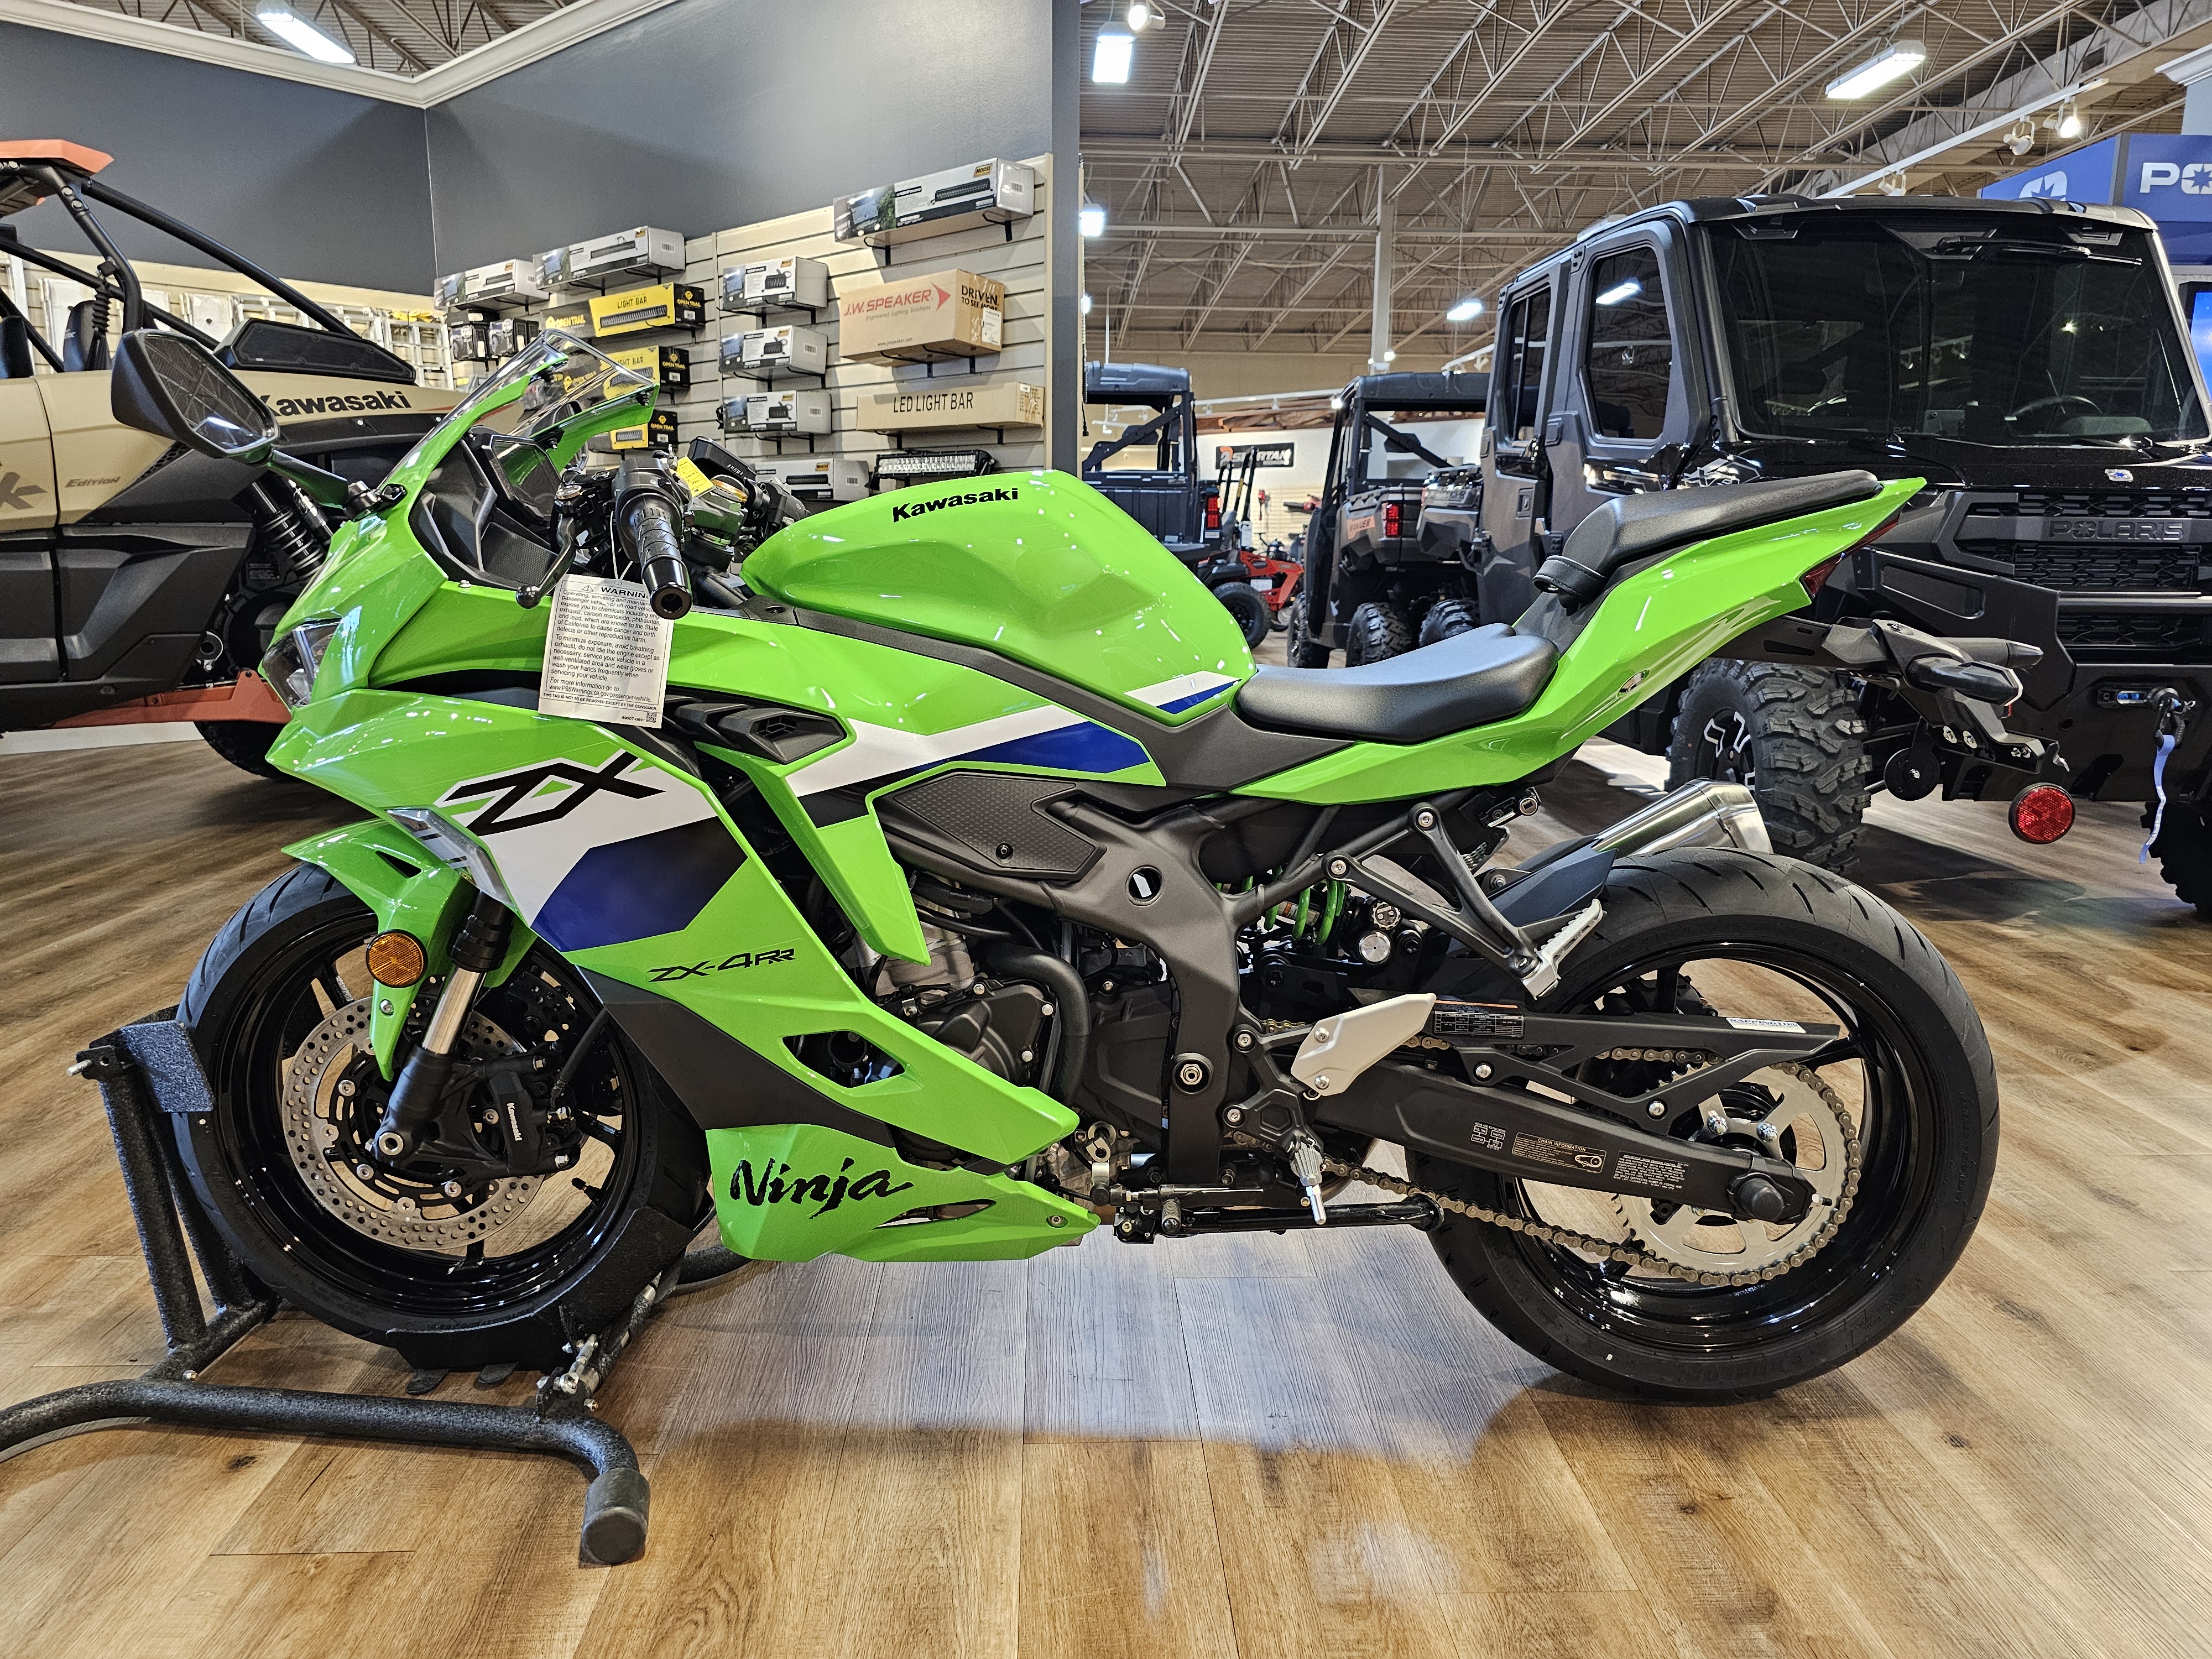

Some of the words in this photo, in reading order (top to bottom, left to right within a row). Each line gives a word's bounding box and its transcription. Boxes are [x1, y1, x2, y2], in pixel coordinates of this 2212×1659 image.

[976, 165, 991, 174] MOOSE
[2140, 162, 2212, 194] PO
[618, 299, 633, 309] LIGHT
[636, 296, 647, 305] BAR
[844, 302, 864, 317] J.W.
[867, 289, 932, 312] SPEAKER
[971, 300, 979, 308] SEE
[866, 312, 890, 321] Engineered
[891, 309, 909, 318] Lighting
[894, 396, 912, 413] LED
[916, 394, 948, 412] LIGHT
[951, 392, 973, 410] BAR
[1233, 450, 1291, 462] SPRTAN
[893, 488, 1018, 523] Kawasaki
[2049, 520, 2184, 540] POLARIS
[601, 587, 649, 598] WARNIN
[625, 609, 648, 618] including
[629, 644, 654, 654] breathing
[553, 655, 591, 665] well-ventilated
[551, 669, 575, 677] servicing
[598, 667, 624, 677] frequently
[576, 680, 604, 690] information
[444, 752, 665, 836] ZX
[648, 948, 796, 982] ZX-4RR
[507, 1103, 523, 1141] Kawasaki
[1553, 1141, 1586, 1152] INFORMATION
[729, 1157, 913, 1219] Ninja
